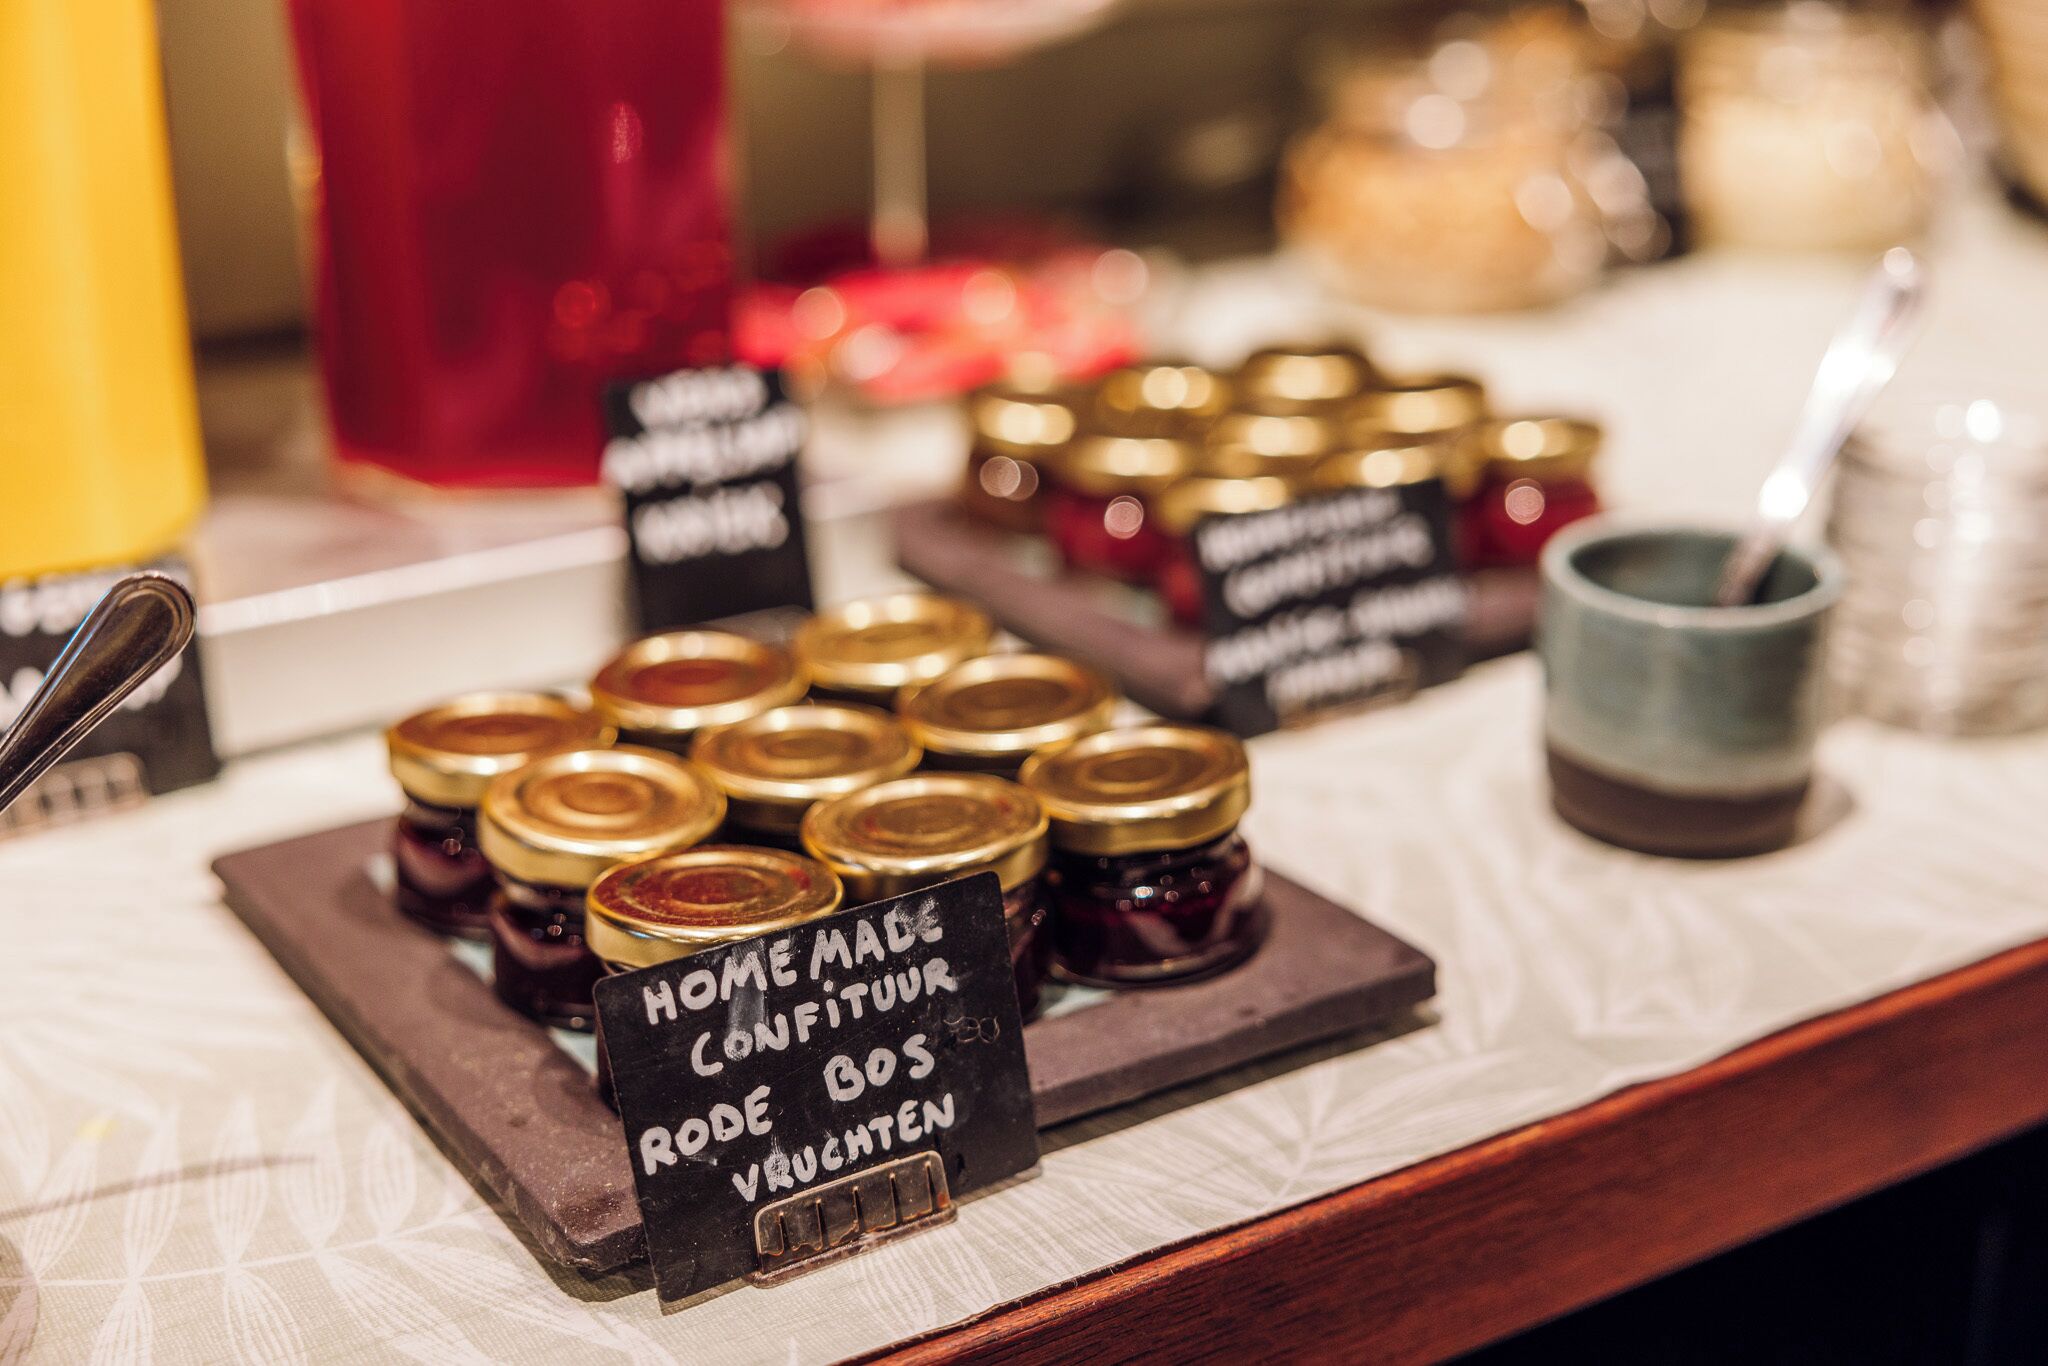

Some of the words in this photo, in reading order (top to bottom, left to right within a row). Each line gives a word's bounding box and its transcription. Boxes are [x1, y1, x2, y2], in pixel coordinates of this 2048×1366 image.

[640, 1087, 772, 1175] RODE
[824, 1034, 935, 1102] BOS
[732, 1093, 955, 1202] VRUCHTEN
